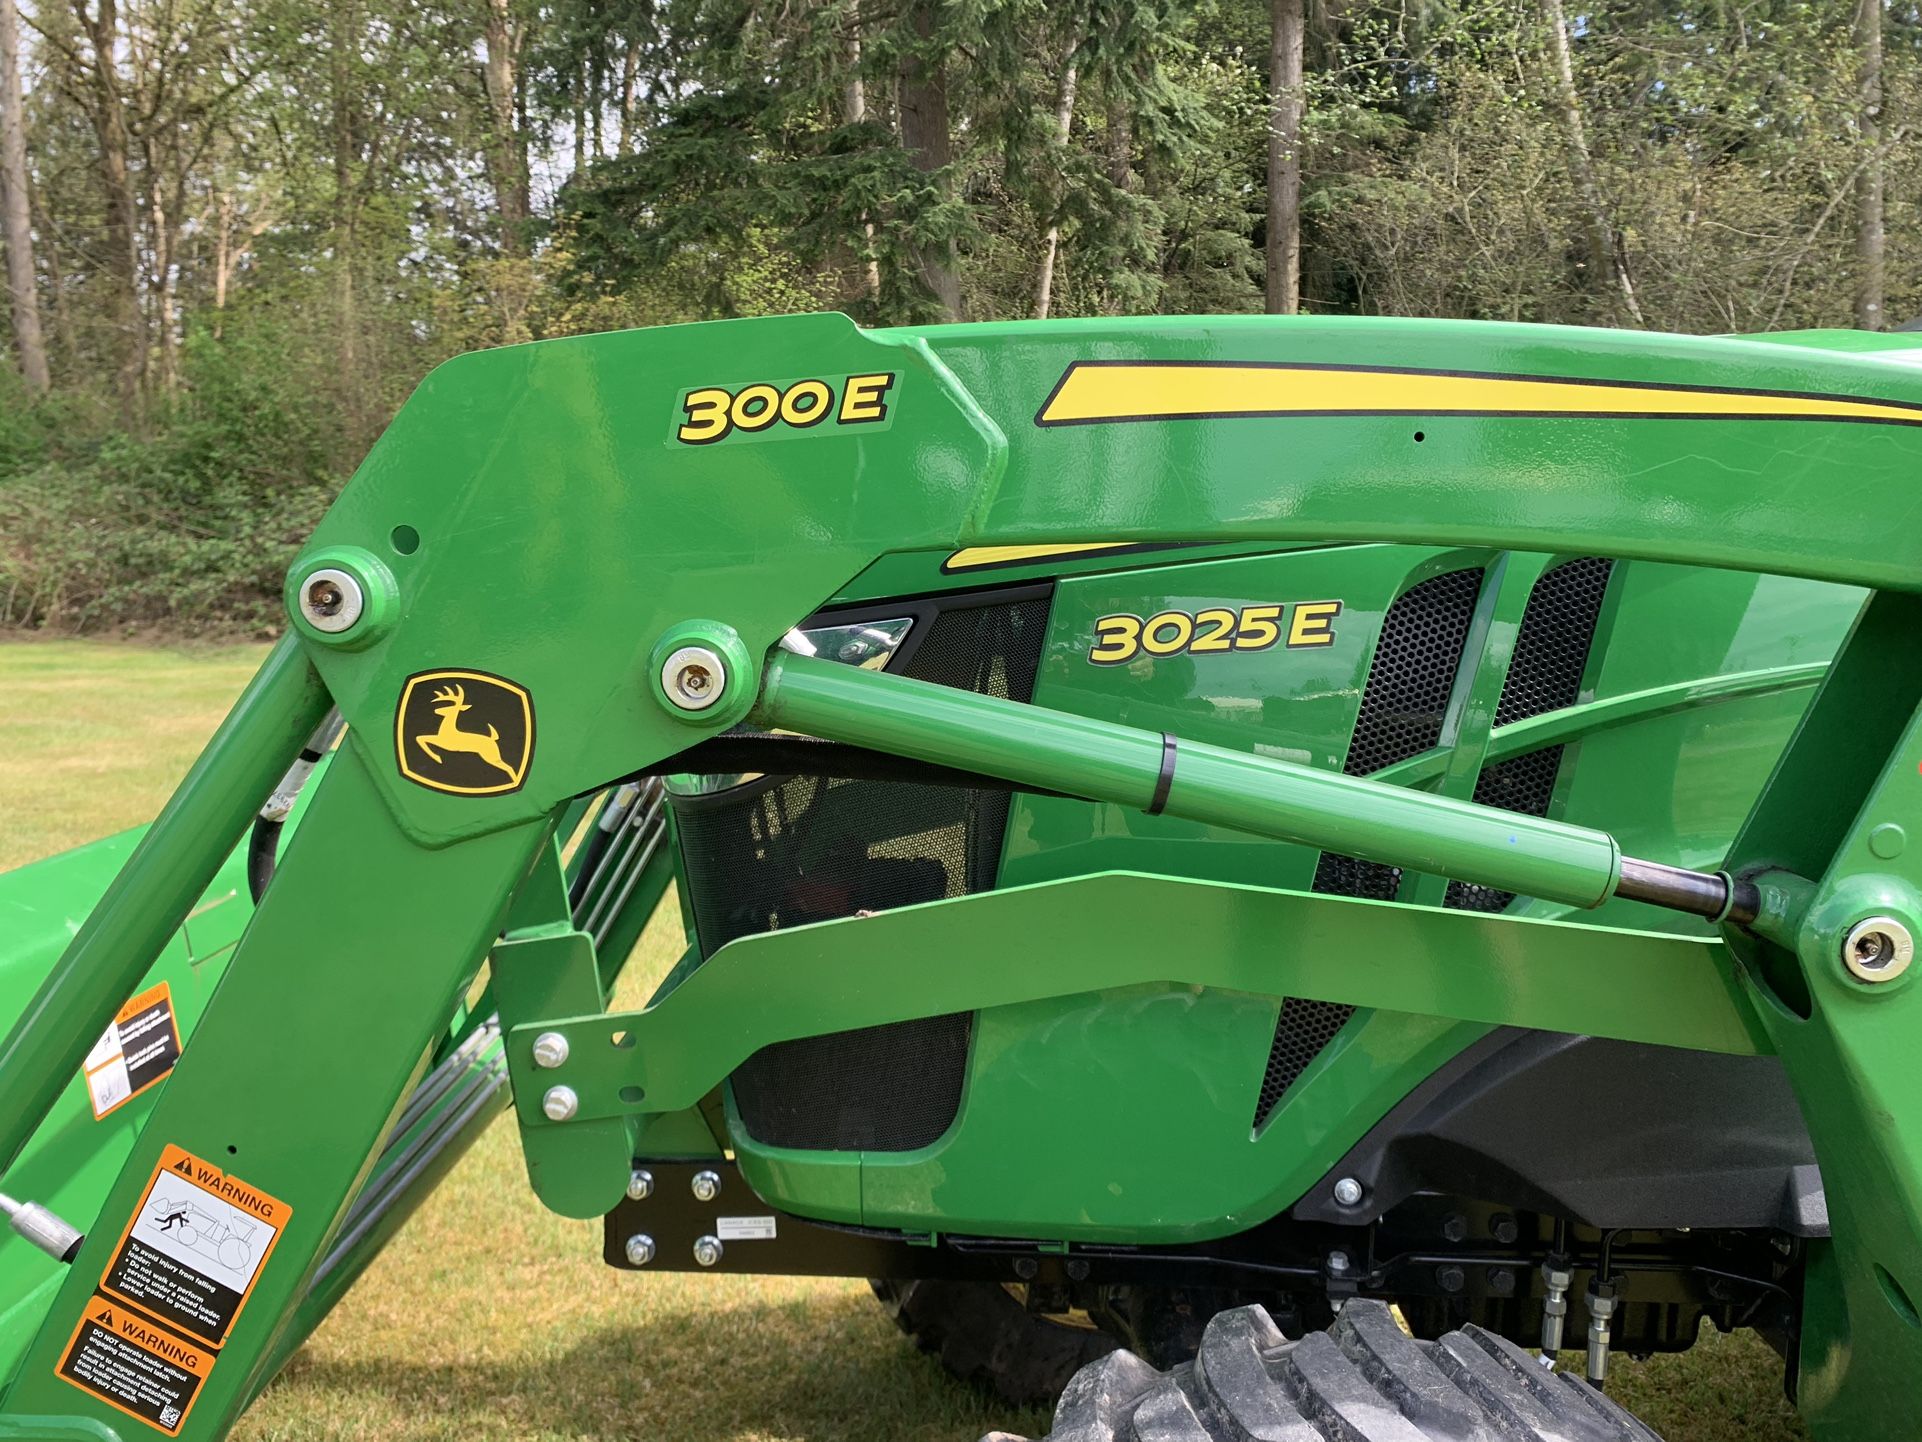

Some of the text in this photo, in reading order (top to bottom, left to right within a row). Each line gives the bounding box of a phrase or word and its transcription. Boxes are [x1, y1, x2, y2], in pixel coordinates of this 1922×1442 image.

[197, 1168, 274, 1218] WARNING
[127, 1250, 151, 1267] loader:
[129, 1260, 140, 1269] Do
[140, 1266, 152, 1276] not
[153, 1273, 168, 1284] walk
[176, 1286, 204, 1303] perform
[132, 1243, 216, 1293] To avoid injury from falling
[119, 1281, 144, 1298] parked.
[123, 1273, 217, 1327] Lower loader to ground when
[127, 1268, 151, 1284] service
[151, 1281, 171, 1294] under
[176, 1294, 199, 1308] raised
[198, 1304, 220, 1321] loader.
[89, 1336, 170, 1382] engaging attachment latch.
[92, 1328, 187, 1382] DO NOT operate loader without
[122, 1320, 198, 1368] WARNING
[73, 1365, 93, 1380] bodily
[93, 1376, 111, 1389] injury
[118, 1390, 138, 1404] death.
[77, 1359, 161, 1406] from loader causing serious
[80, 1353, 99, 1366] result
[105, 1367, 141, 1388] attachment
[140, 1385, 172, 1405] detaching
[83, 1345, 180, 1399] Failure to engage retainer could
